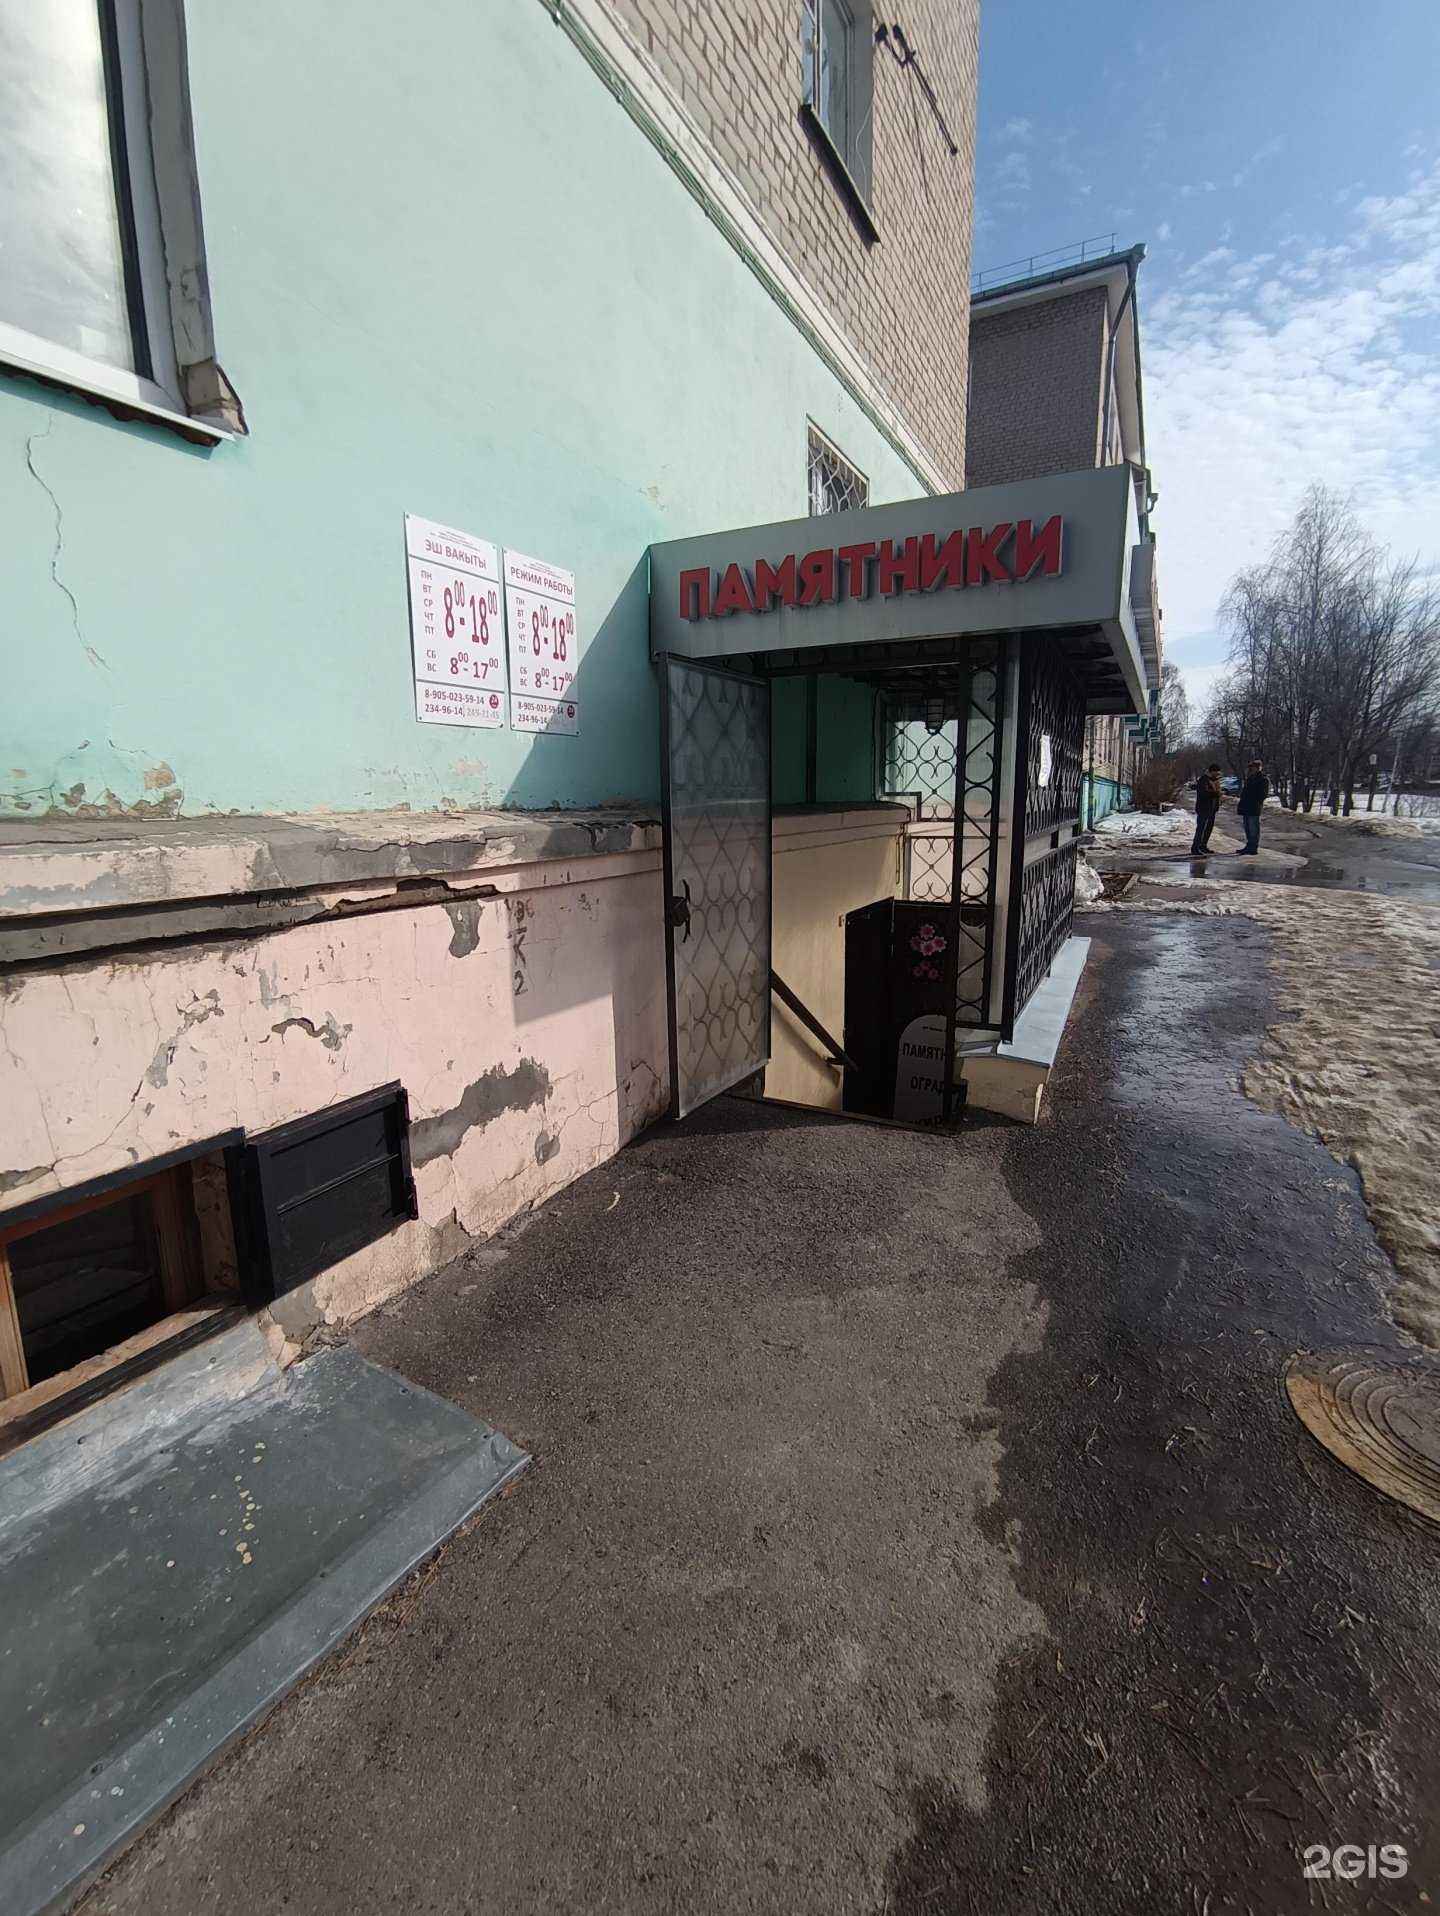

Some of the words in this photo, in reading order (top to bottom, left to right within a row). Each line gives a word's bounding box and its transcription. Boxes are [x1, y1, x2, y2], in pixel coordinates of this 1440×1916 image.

[425, 539, 443, 555] ЭШ
[445, 546, 487, 569] ВАКЫТЫ
[680, 515, 1063, 619] ПАМЯТНИКИ
[510, 566, 541, 585] РЕЖИМ
[543, 579, 573, 595] РАБОТЫ
